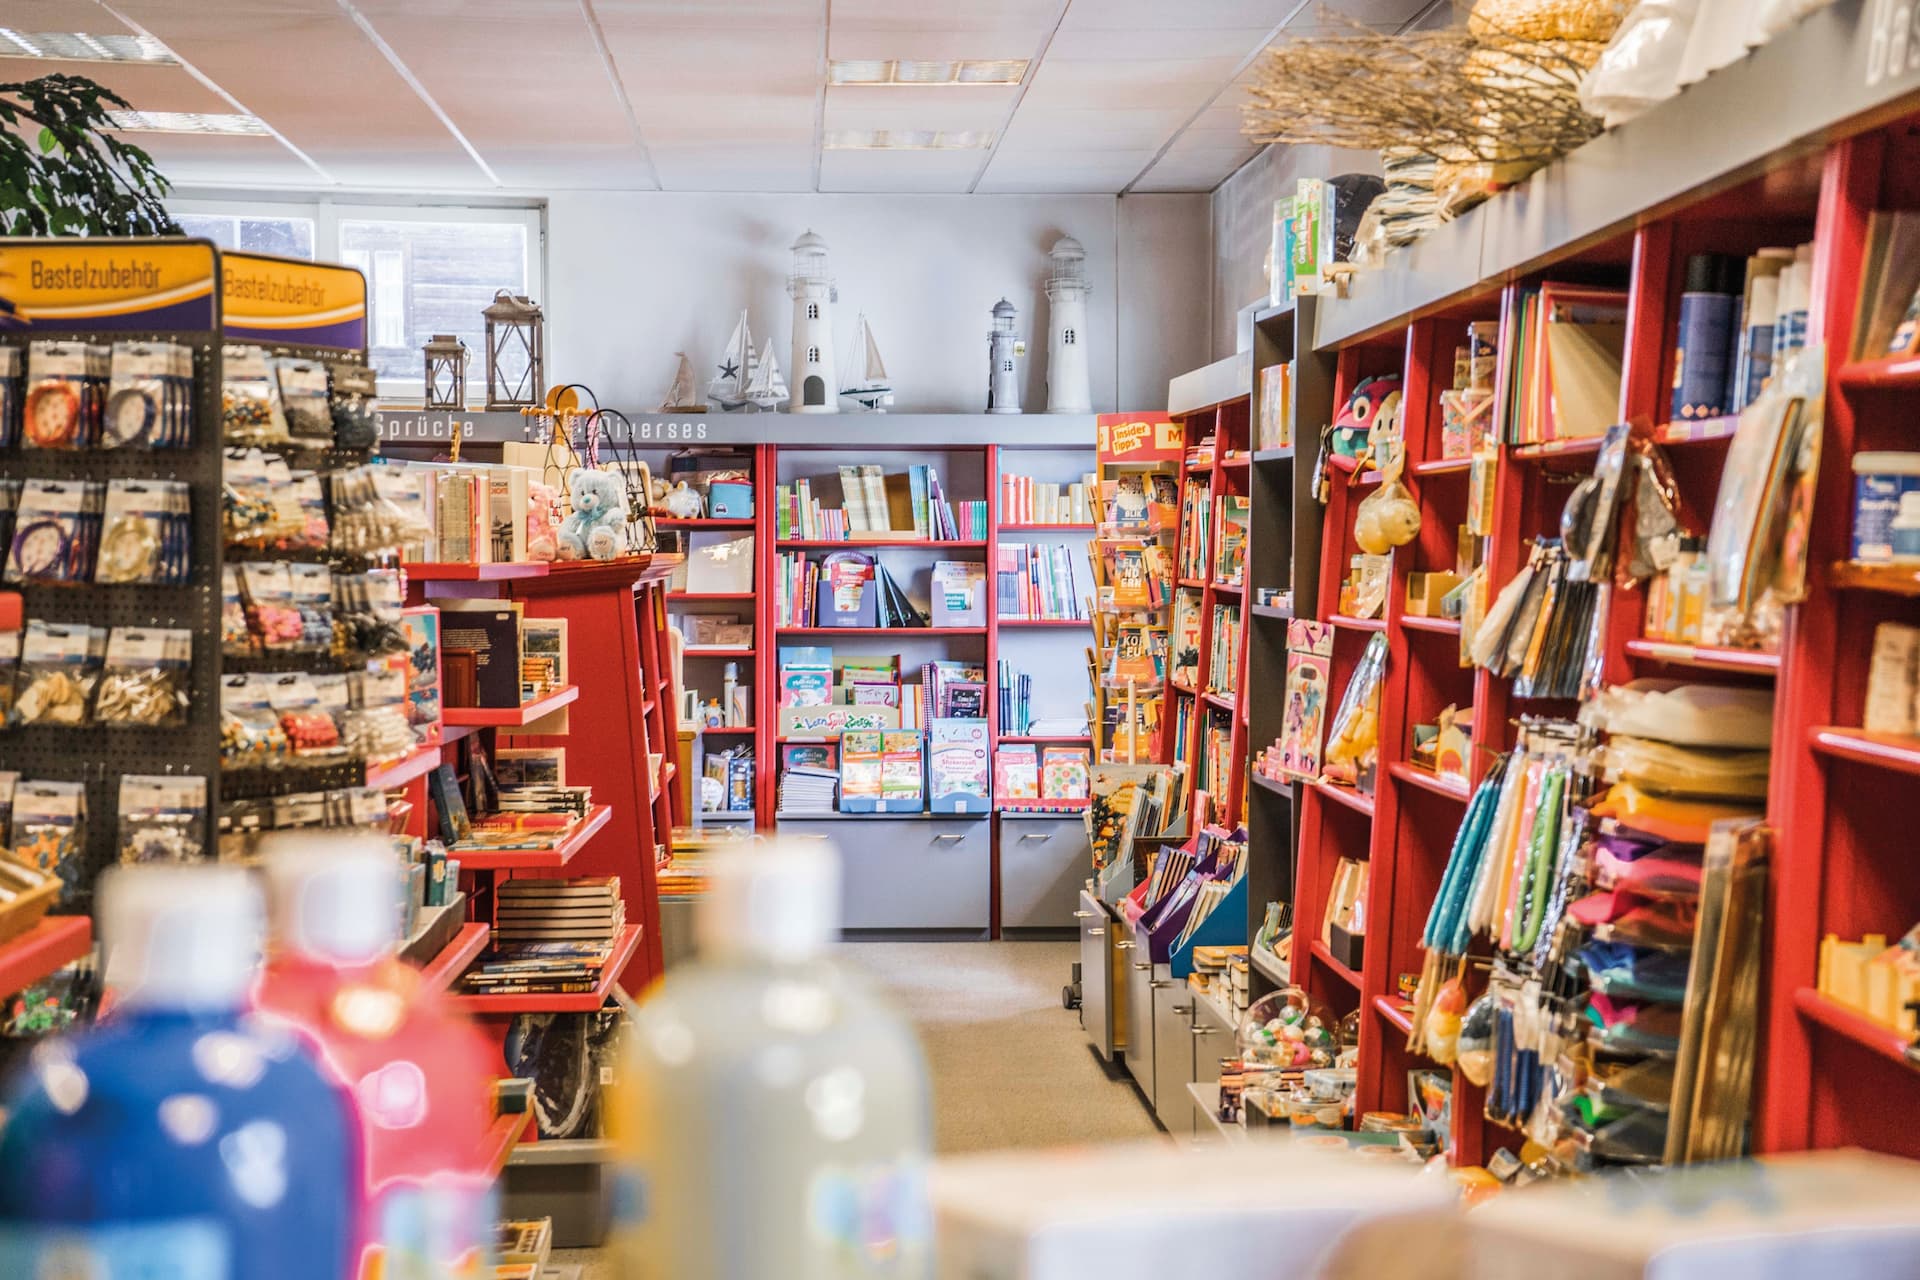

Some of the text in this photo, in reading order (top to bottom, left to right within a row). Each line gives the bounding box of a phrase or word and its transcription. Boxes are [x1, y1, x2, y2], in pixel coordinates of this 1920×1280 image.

[31, 258, 161, 290] Bastelzubehör
[223, 268, 326, 307] Bastelzubehör
[374, 412, 474, 441] Sprüche
[599, 415, 707, 439] Diverses
[1116, 425, 1146, 439] Insider
[1114, 439, 1135, 451] Tipps
